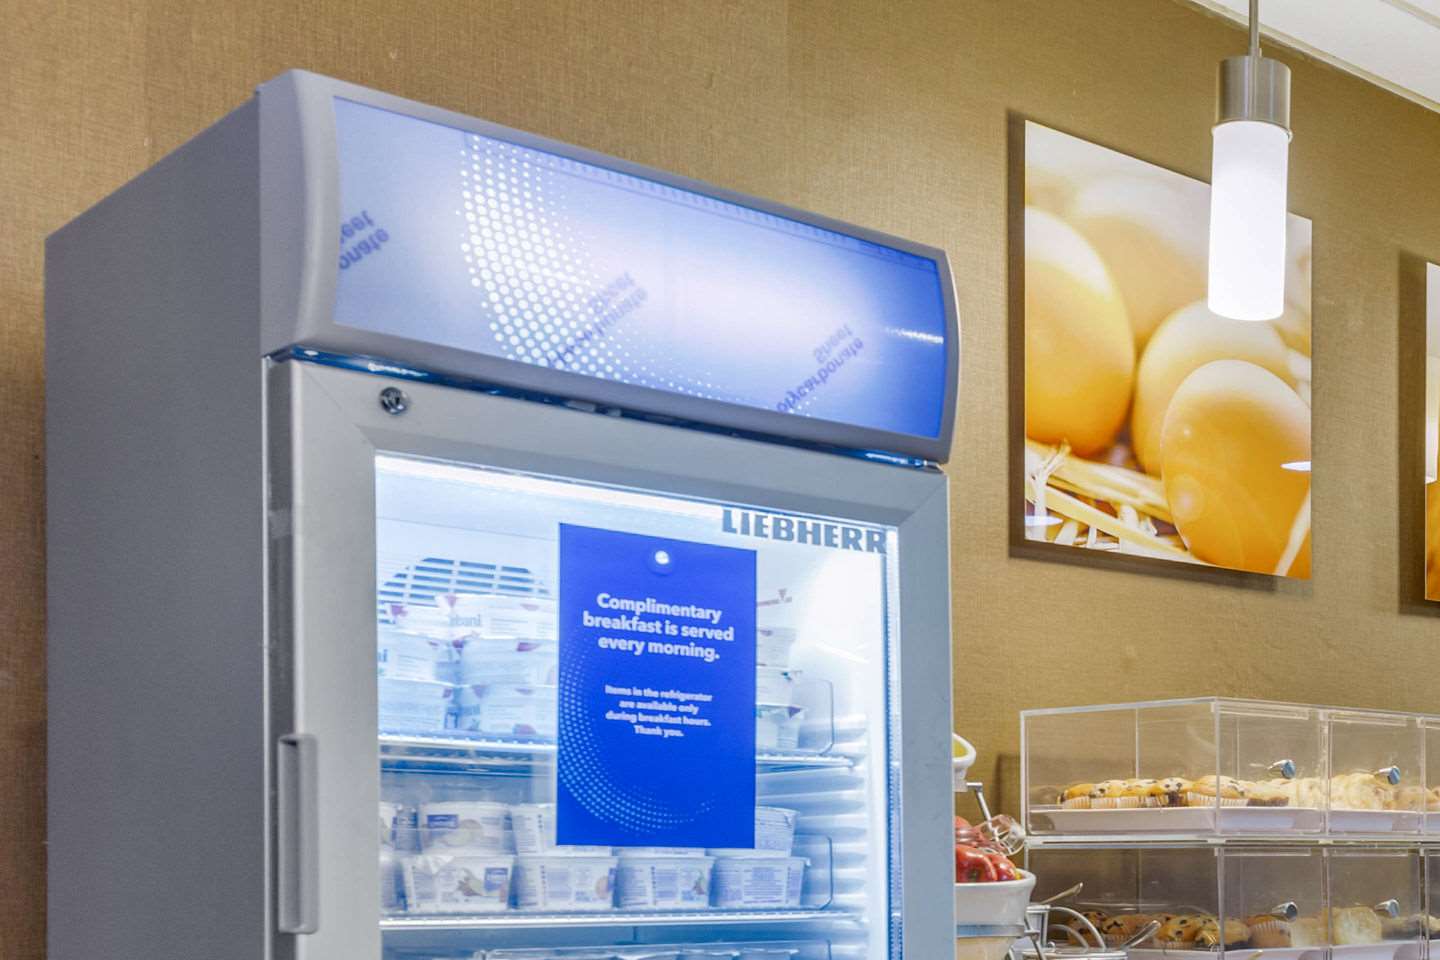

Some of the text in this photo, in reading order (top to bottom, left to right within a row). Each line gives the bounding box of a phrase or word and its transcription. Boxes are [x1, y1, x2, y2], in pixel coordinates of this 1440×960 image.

[722, 509, 887, 554] LIEBHERR
[596, 593, 722, 624] Complimentary
[583, 610, 735, 641] breakfast is served
[598, 636, 720, 663] every morning.
[605, 684, 713, 702] Items in the refrigerator
[605, 710, 637, 723] during
[638, 712, 682, 725] breakfast
[619, 700, 699, 715] are available only
[633, 724, 663, 736] Thank
